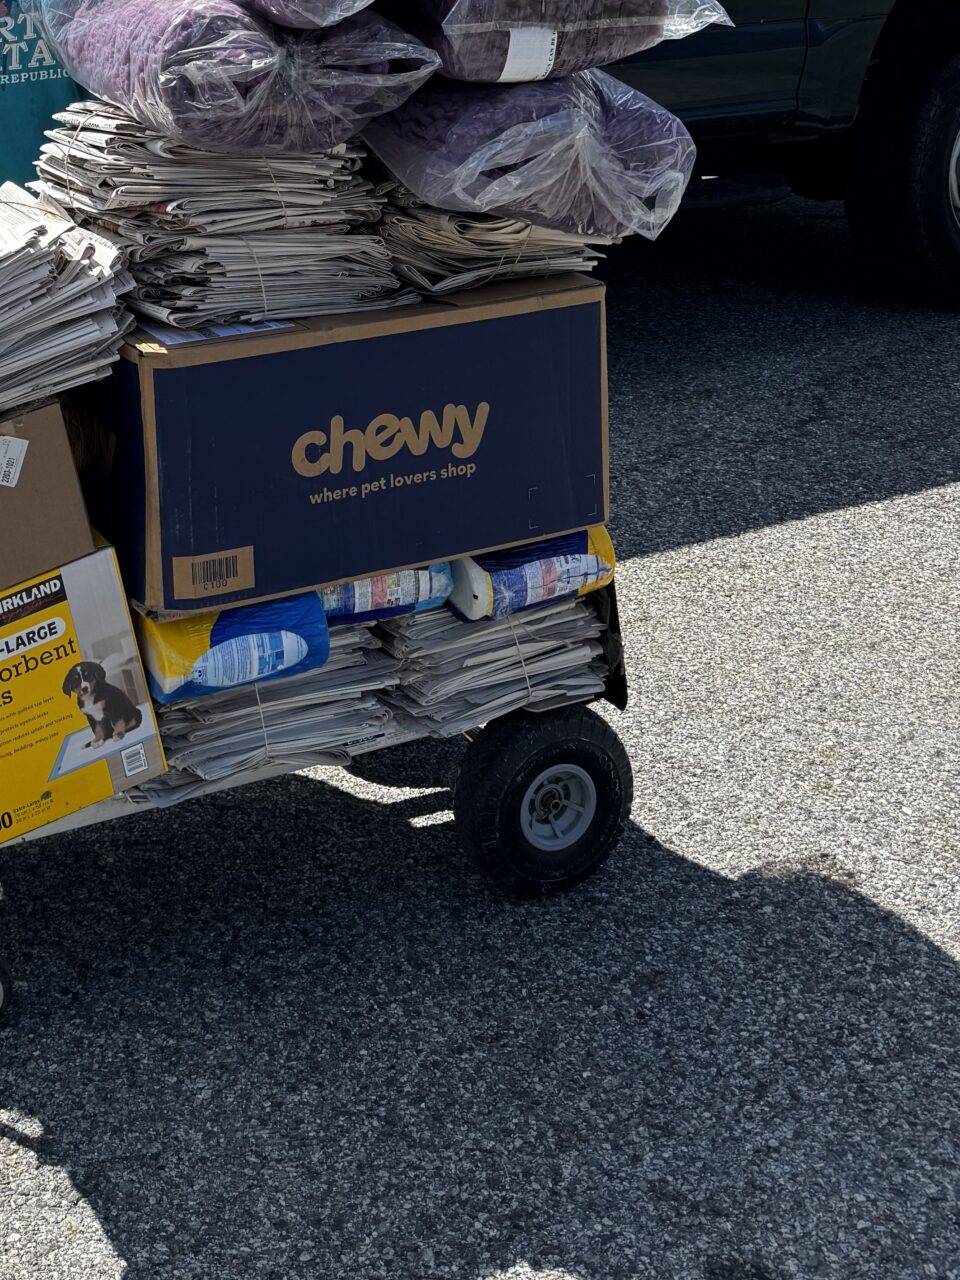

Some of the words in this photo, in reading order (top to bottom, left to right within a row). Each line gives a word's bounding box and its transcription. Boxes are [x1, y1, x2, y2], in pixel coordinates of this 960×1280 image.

[0, 69, 70, 84] REPUBLIC
[291, 401, 490, 478] chewy
[309, 483, 358, 505] where
[361, 475, 387, 499] pet
[390, 467, 437, 491] lovers
[440, 460, 477, 481] shop
